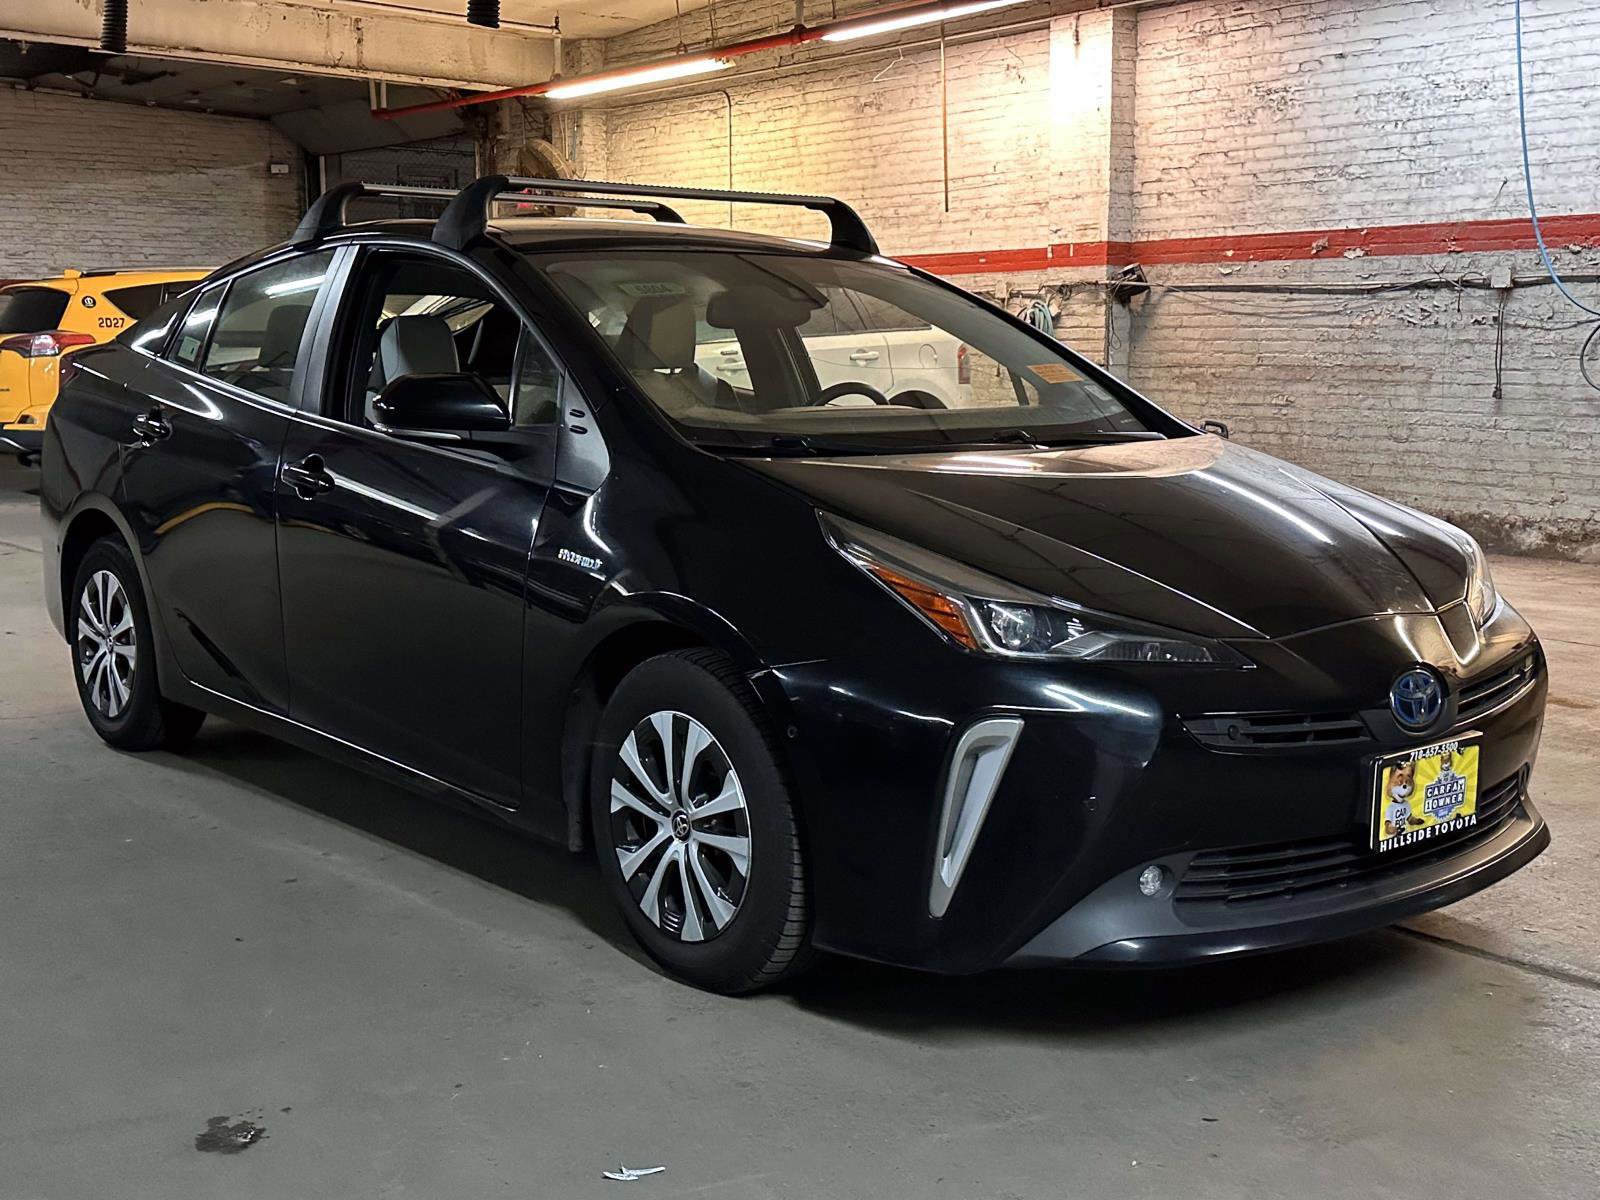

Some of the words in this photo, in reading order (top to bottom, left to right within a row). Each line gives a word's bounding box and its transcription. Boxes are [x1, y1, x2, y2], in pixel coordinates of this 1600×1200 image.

[97, 317, 125, 328] 2027
[1409, 741, 1459, 762] 718-657-5500
[1426, 778, 1465, 798] CARFAX
[1432, 793, 1463, 809] OWNER
[1380, 829, 1432, 853] HILLSIDE
[1434, 814, 1477, 836] TOYOTA
